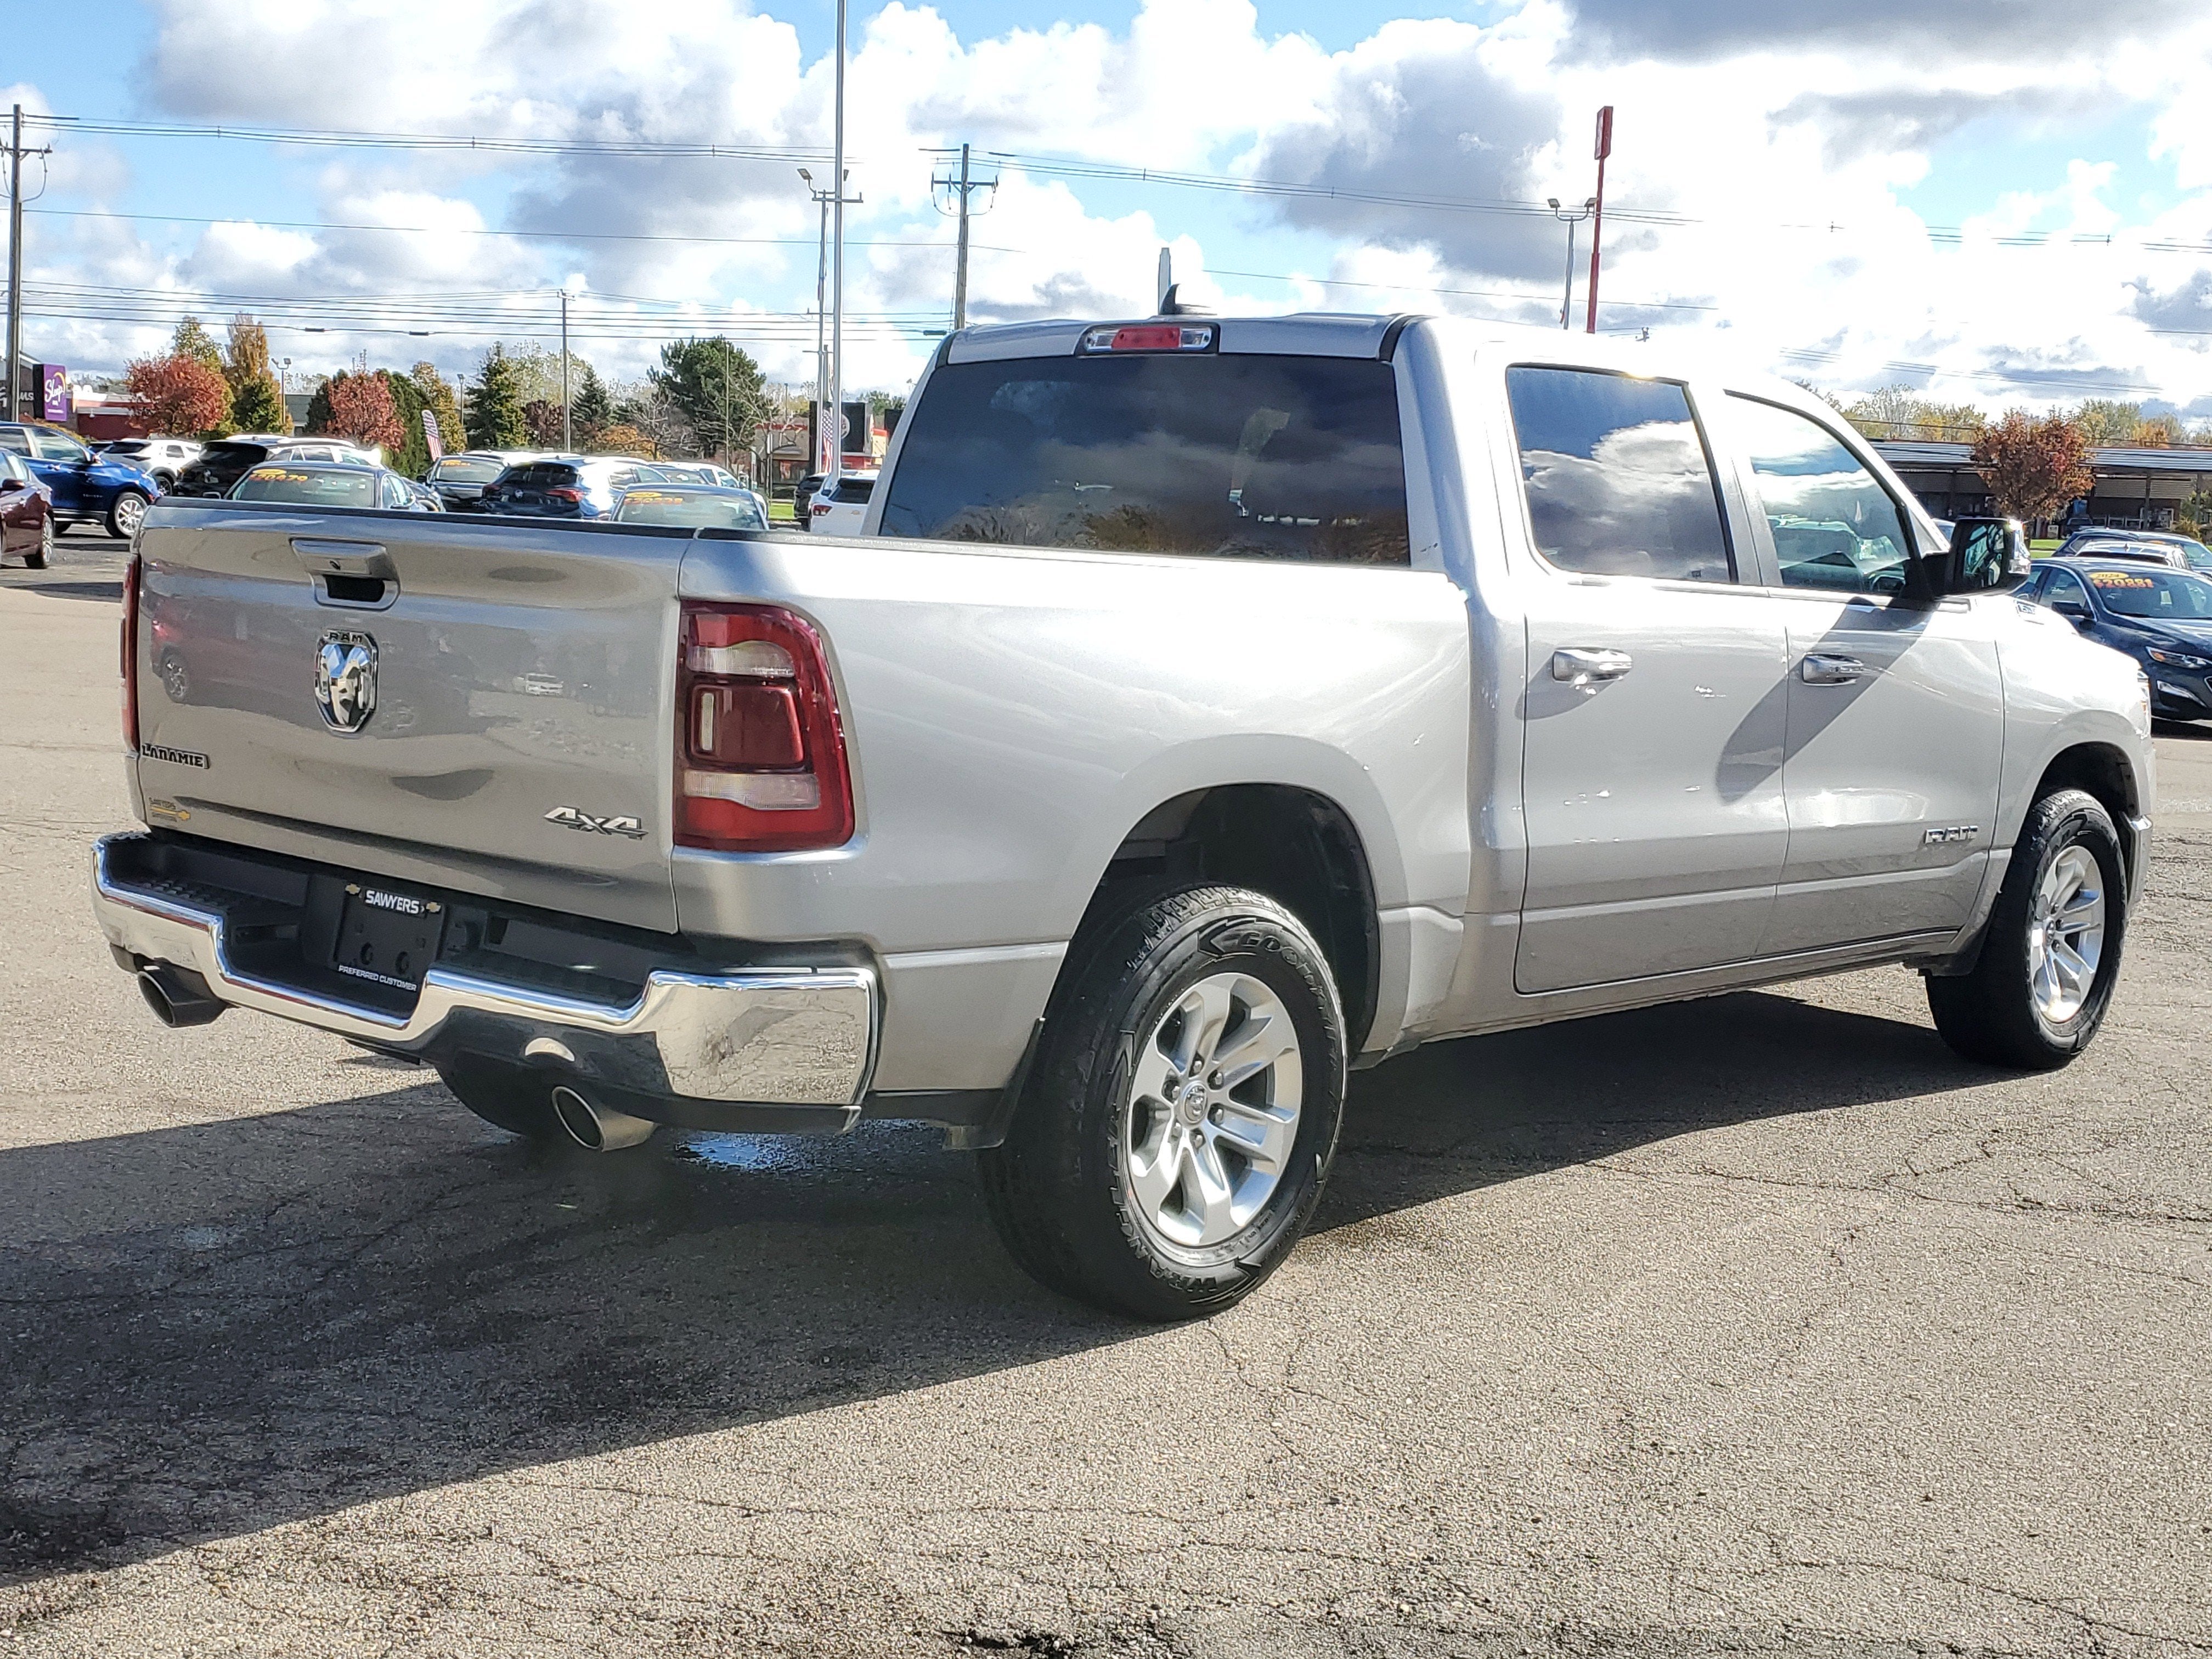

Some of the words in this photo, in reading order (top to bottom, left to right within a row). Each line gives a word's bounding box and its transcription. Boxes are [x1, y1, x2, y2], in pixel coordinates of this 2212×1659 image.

[329, 632, 363, 643] RAM
[142, 744, 204, 768] LARAMIE
[1924, 825, 1978, 844] RAM
[365, 889, 420, 914] SAWYERS
[338, 964, 379, 981] PREFERRED
[379, 975, 417, 992] CUSTOMER
